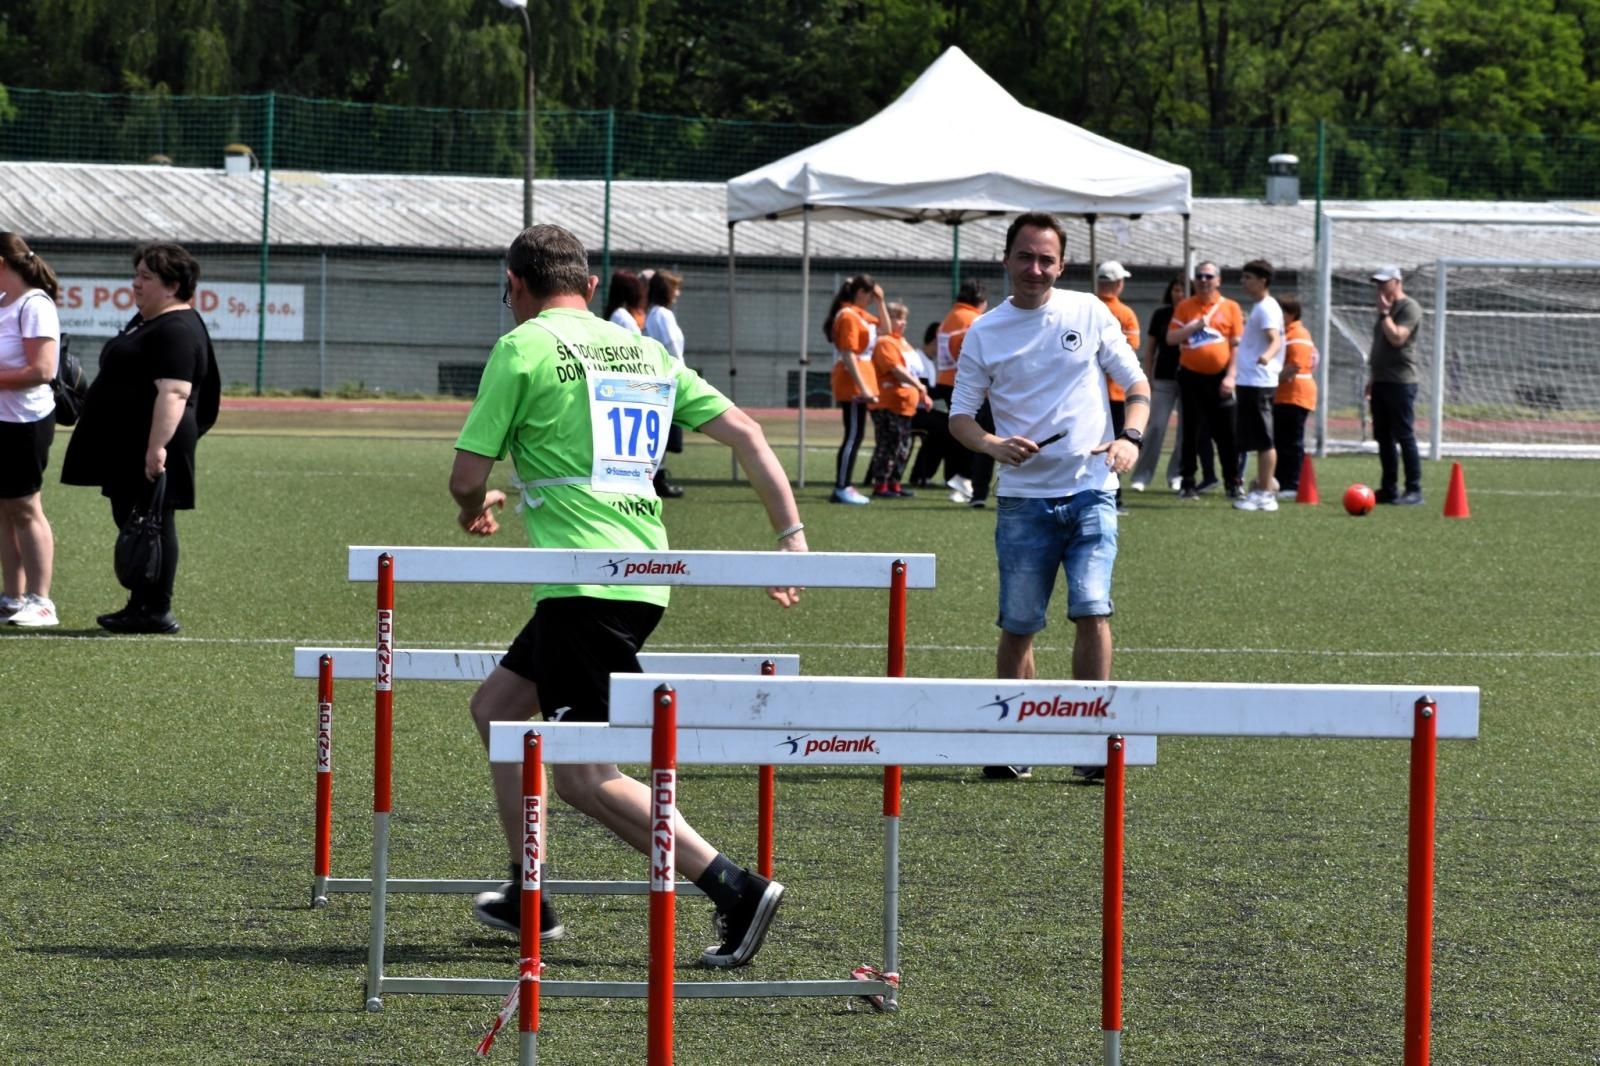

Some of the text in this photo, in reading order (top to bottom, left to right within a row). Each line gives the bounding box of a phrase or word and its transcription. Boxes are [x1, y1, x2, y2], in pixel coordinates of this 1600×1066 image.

[93, 286, 219, 313] POD
[228, 296, 250, 317] Sp.
[556, 362, 587, 383] DOM
[607, 407, 660, 459] 179
[624, 559, 687, 577] polanik
[378, 611, 390, 684] POLANIK
[1017, 695, 1111, 722] polanik
[319, 704, 330, 767] POLANIK
[804, 734, 876, 757] polanik
[524, 798, 539, 882] POLANIK
[654, 772, 673, 881] POLANIK
